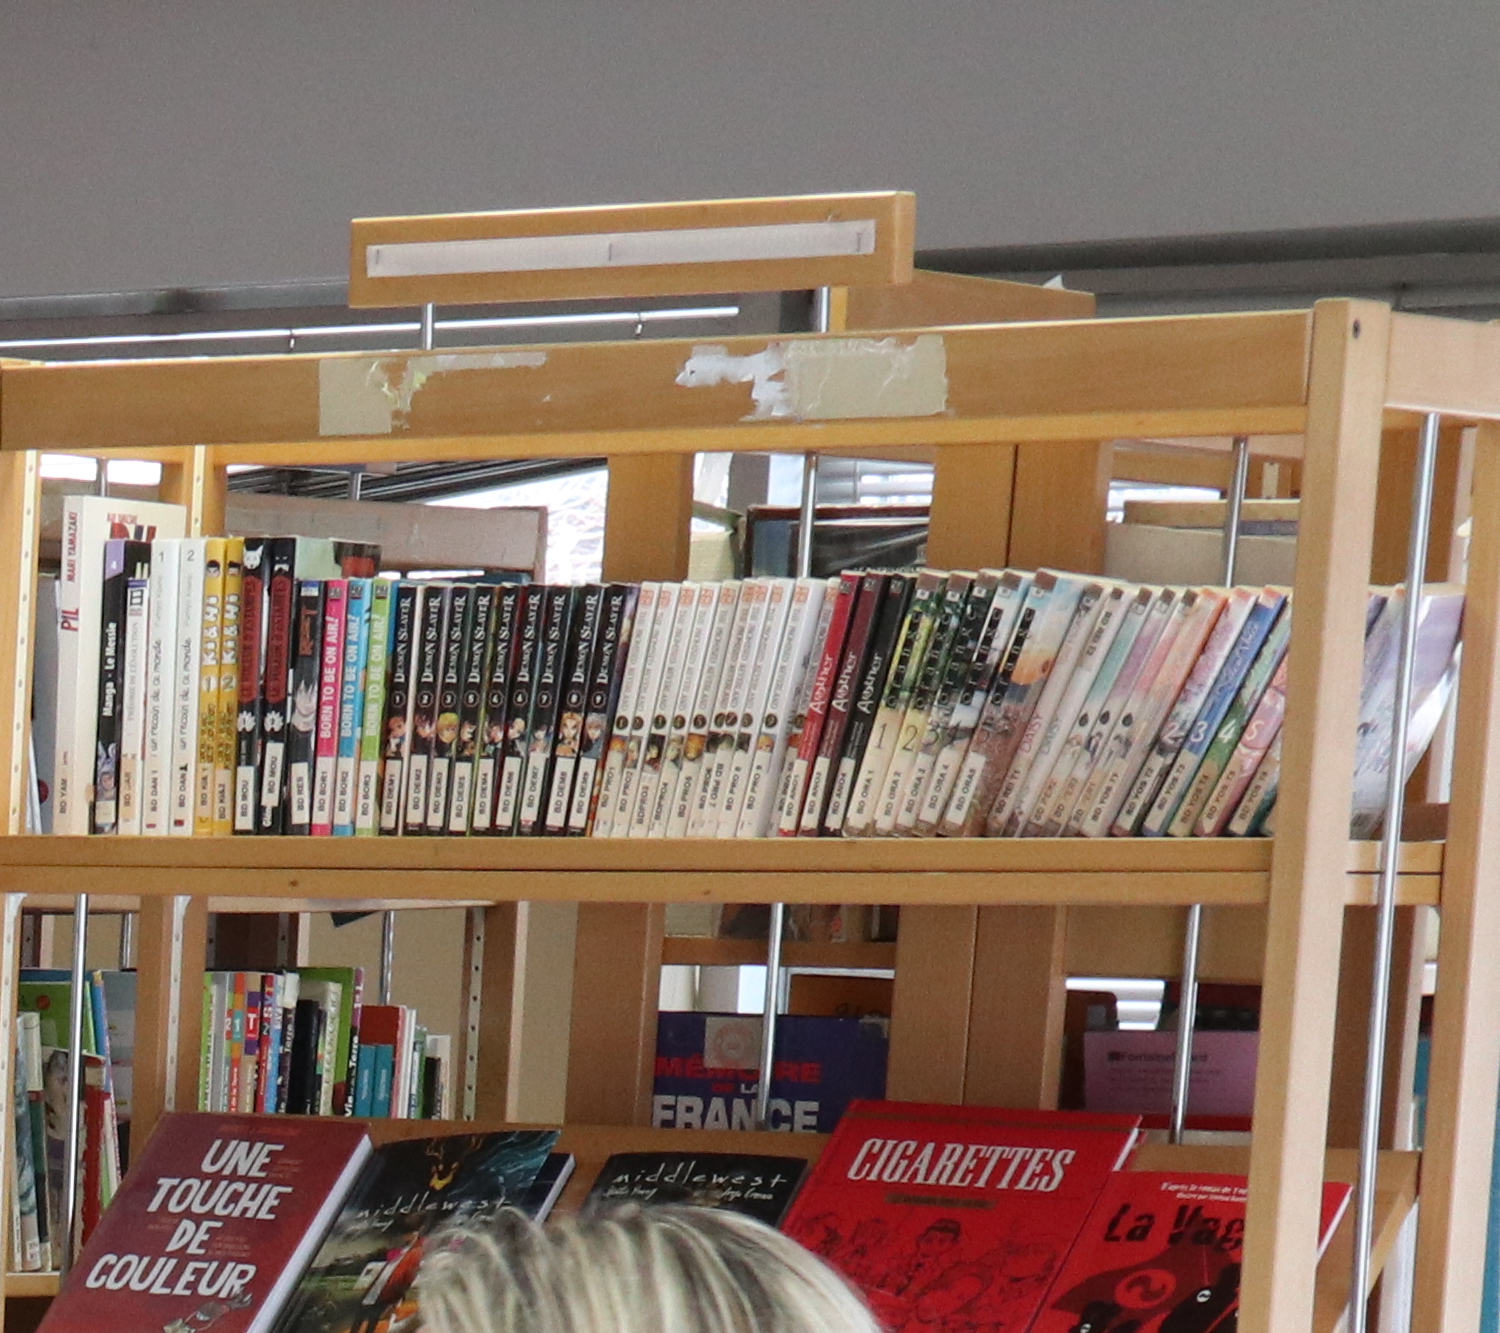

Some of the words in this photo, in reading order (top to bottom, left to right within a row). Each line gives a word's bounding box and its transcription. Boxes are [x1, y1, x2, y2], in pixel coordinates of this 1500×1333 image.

[67, 511, 78, 557] YAMAZAKI
[158, 551, 166, 563] 1
[187, 549, 196, 563] 2
[66, 559, 77, 583] MARI
[60, 607, 79, 633] PIL
[204, 594, 219, 623] Hi
[224, 592, 242, 622] Hi
[398, 594, 412, 641] SLAYER
[426, 594, 442, 641] SLAYER
[450, 594, 466, 641] SLAYER
[474, 594, 491, 641] SLAYER
[499, 594, 515, 641] SLAYER
[524, 594, 541, 641] SLAYER
[548, 594, 566, 641] SLAYER
[580, 594, 598, 641] SLAYER
[605, 594, 623, 641] SLAYER
[203, 624, 219, 640] &
[223, 623, 239, 639] &
[326, 614, 340, 642] AIR!
[348, 613, 361, 641] AIR!
[372, 613, 386, 642] AIR!
[153, 638, 162, 672] monde
[183, 638, 192, 672] monde
[202, 640, 218, 667] Ki
[222, 638, 238, 666] Ki
[325, 643, 337, 665] ON
[347, 642, 358, 664] ON
[370, 642, 383, 663] ON
[324, 665, 335, 684] BE
[345, 664, 356, 683] BE
[369, 663, 381, 682] BE
[102, 682, 114, 718] Manga
[322, 684, 334, 703] TO
[343, 683, 354, 702] TO
[367, 683, 380, 702] TO
[319, 703, 331, 739] BORN
[340, 703, 352, 738] BORN
[364, 702, 377, 737] BORN
[1160, 723, 1178, 742] 2
[1190, 720, 1208, 742] 3
[1218, 719, 1236, 742] 4
[1245, 719, 1259, 740] 5
[873, 722, 888, 750] 1
[901, 724, 919, 751] 2
[652, 1094, 820, 1133] FRANCE
[200, 1138, 286, 1179] UNE
[846, 1136, 1077, 1194] CIGARETTES
[611, 1159, 788, 1190] middlewest
[146, 1176, 294, 1221] TOUCHE
[356, 1190, 512, 1222] middlewest
[164, 1218, 223, 1256] DE
[1103, 1202, 1156, 1243] La
[84, 1253, 258, 1300] COULEUR
